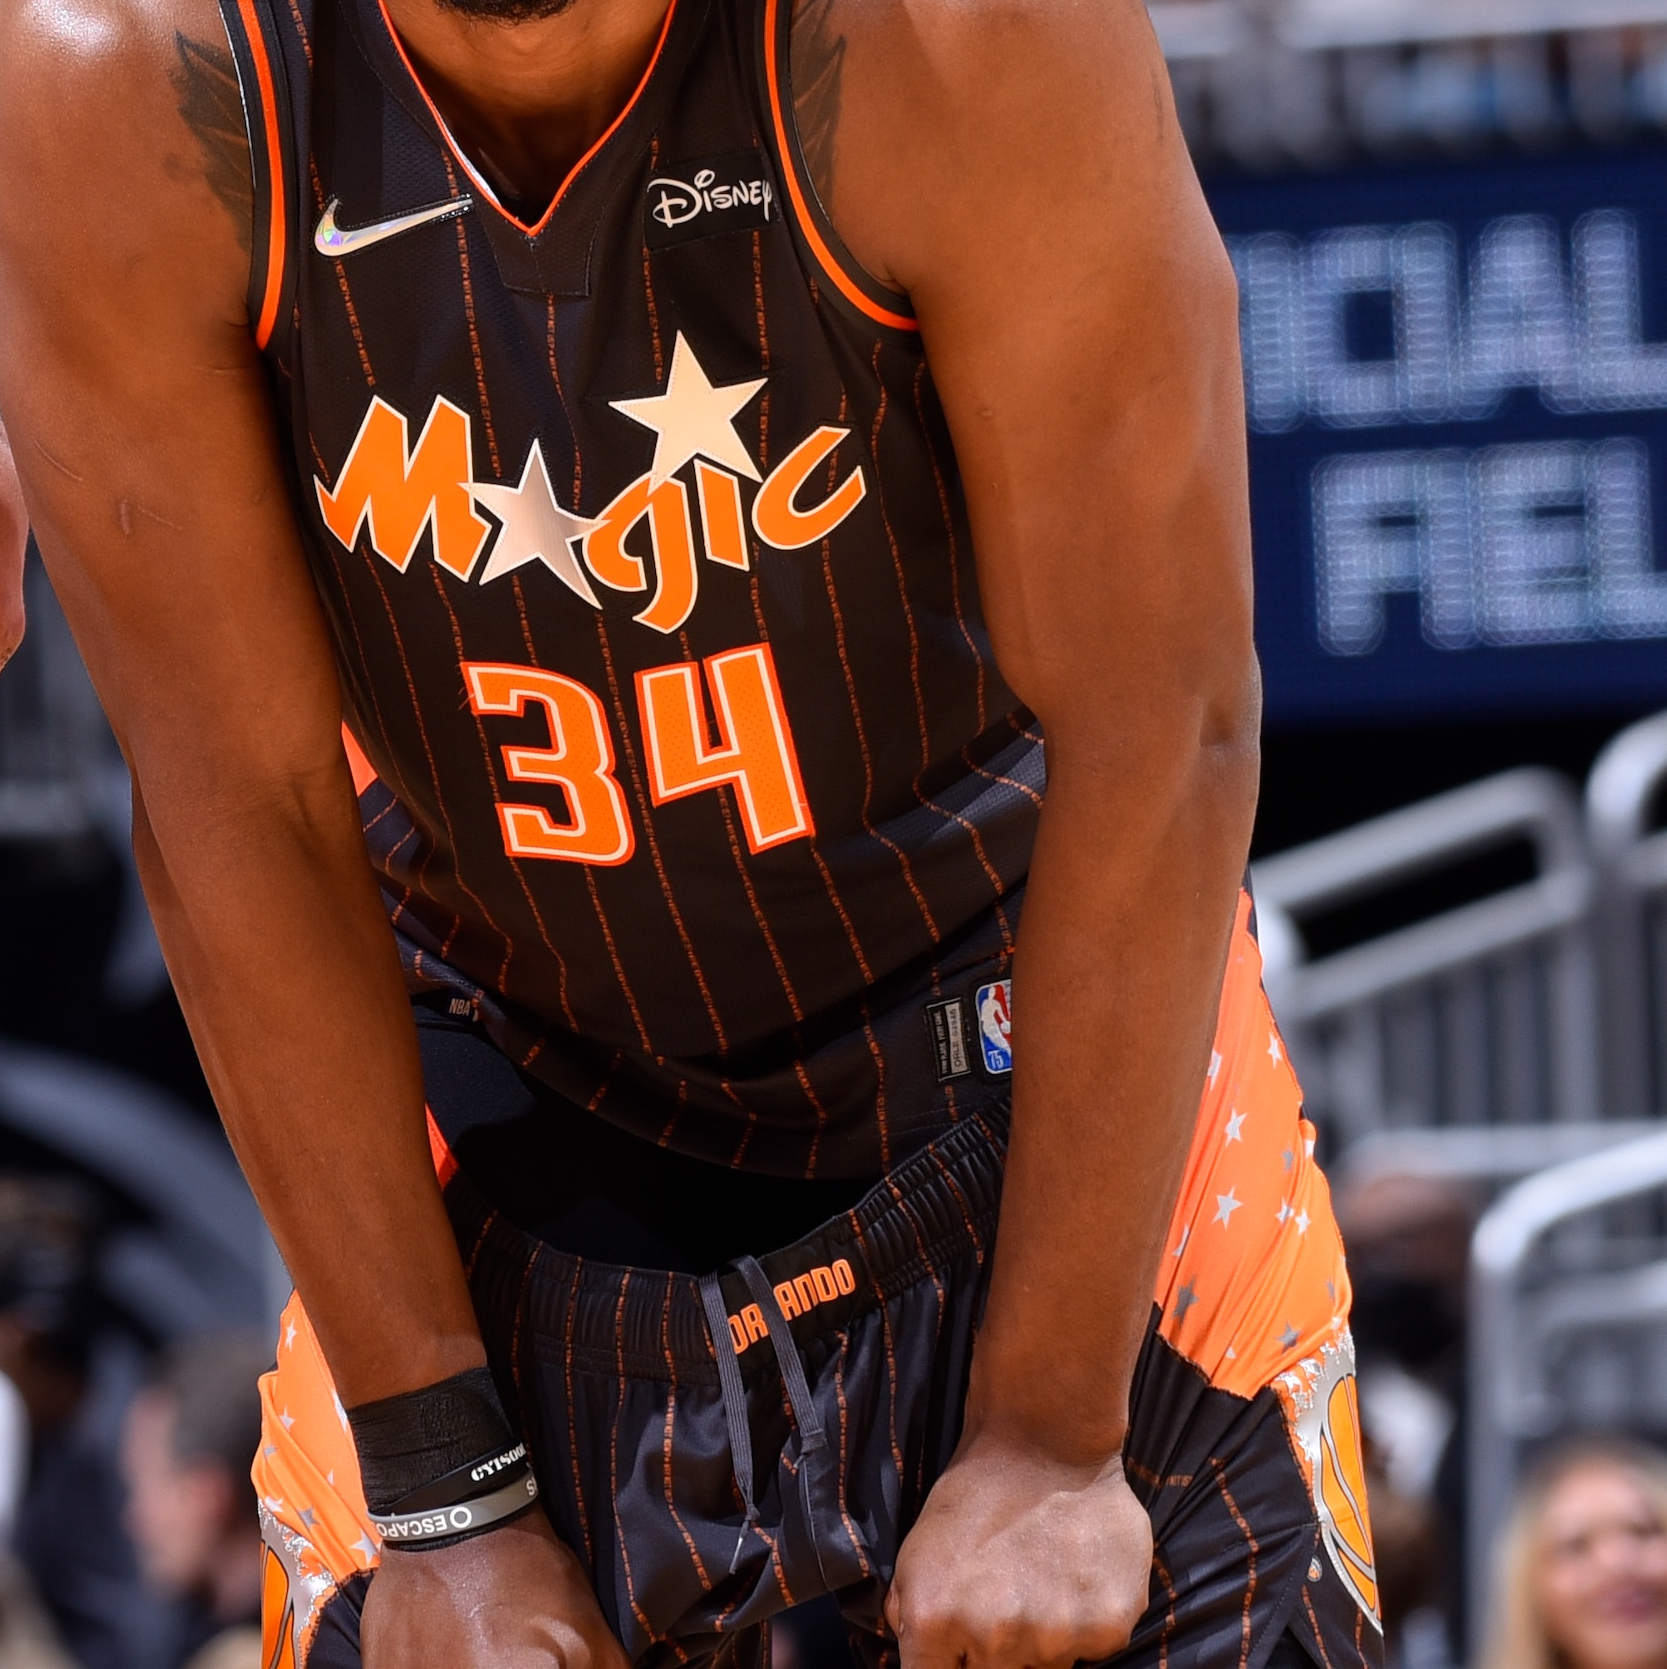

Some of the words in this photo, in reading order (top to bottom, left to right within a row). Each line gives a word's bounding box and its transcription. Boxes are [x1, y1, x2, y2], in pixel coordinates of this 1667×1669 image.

[647, 168, 772, 228] Disney
[459, 642, 816, 867] 34
[987, 1050, 1004, 1069] 75
[727, 1258, 856, 1355] ORANDO
